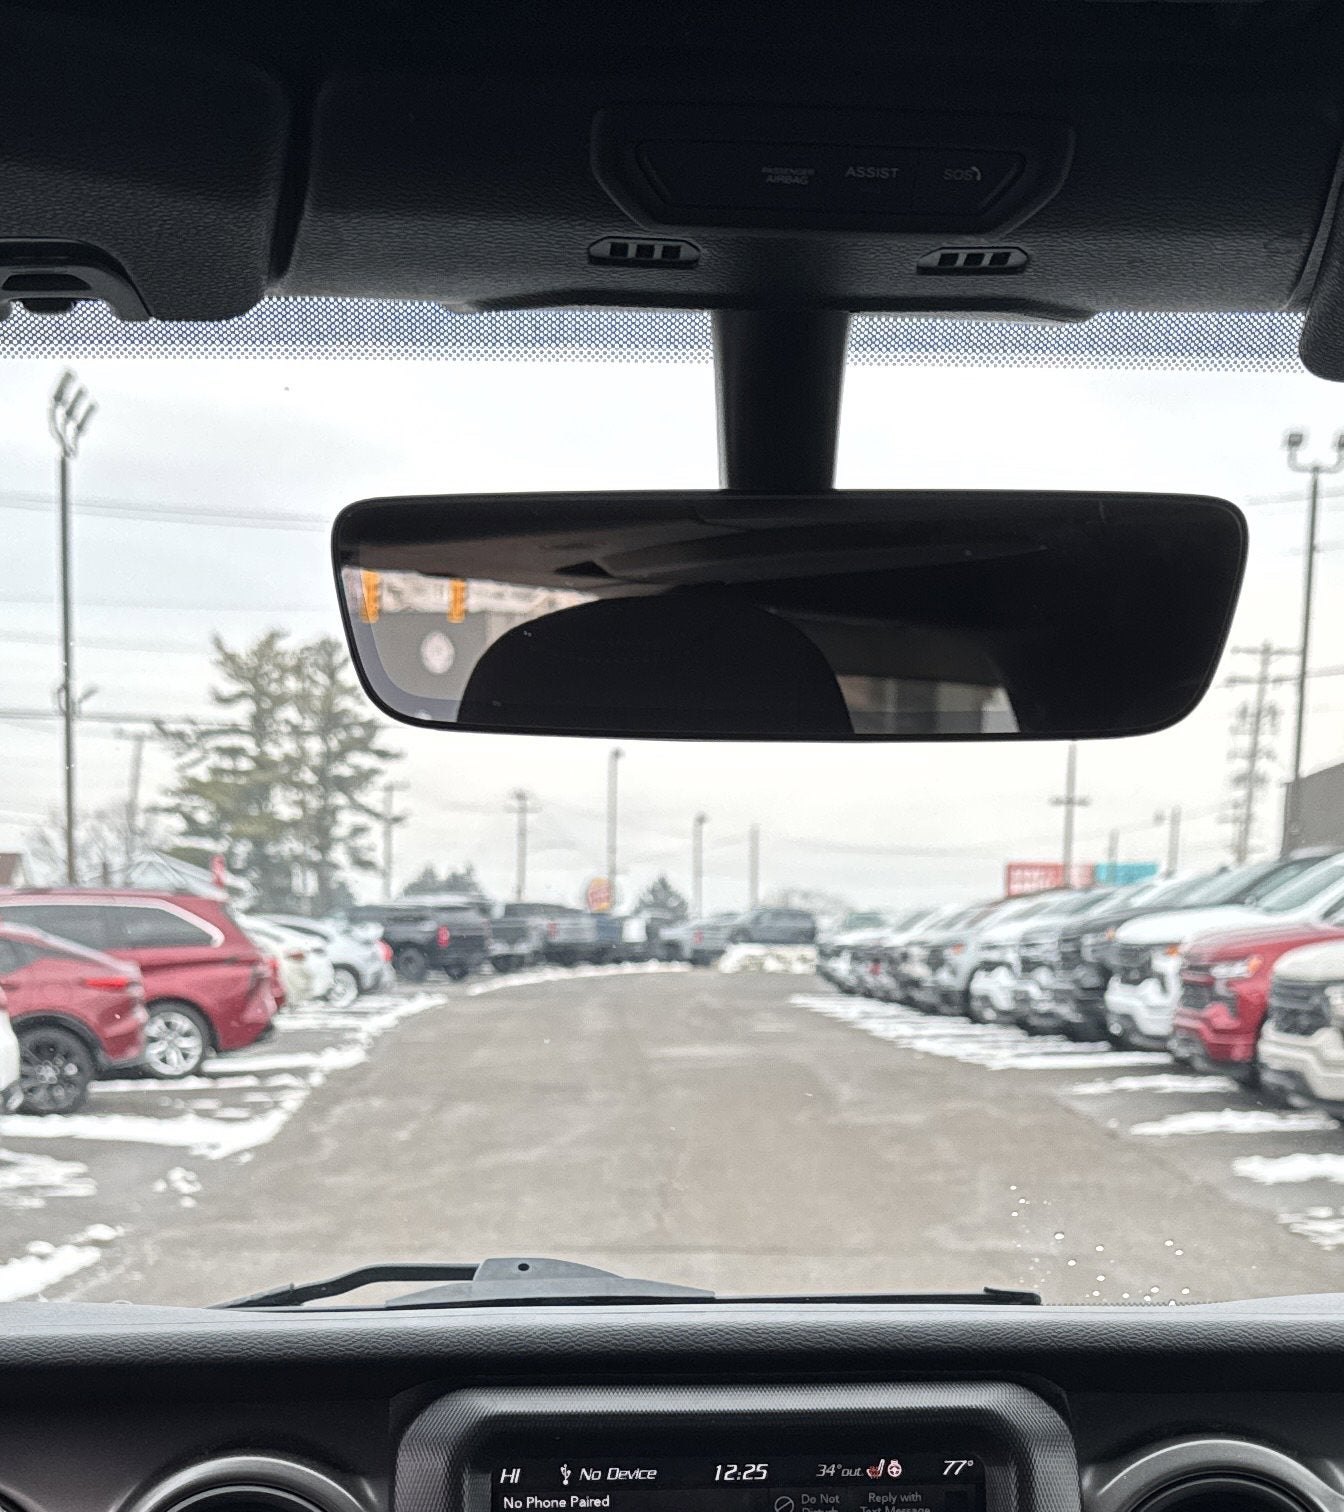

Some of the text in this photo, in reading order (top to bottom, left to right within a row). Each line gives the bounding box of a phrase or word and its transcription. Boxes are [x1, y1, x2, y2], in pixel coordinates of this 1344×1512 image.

[845, 166, 900, 179] ASSIST
[944, 168, 972, 181] SOS
[766, 175, 809, 186] AIRBAG
[499, 1468, 521, 1484] HI
[578, 1466, 658, 1481] No Device
[713, 1464, 769, 1483] 12:25
[503, 1494, 610, 1509] No Phone Paired
[800, 1493, 840, 1505] Do Not
[867, 1491, 922, 1506] Reply with
